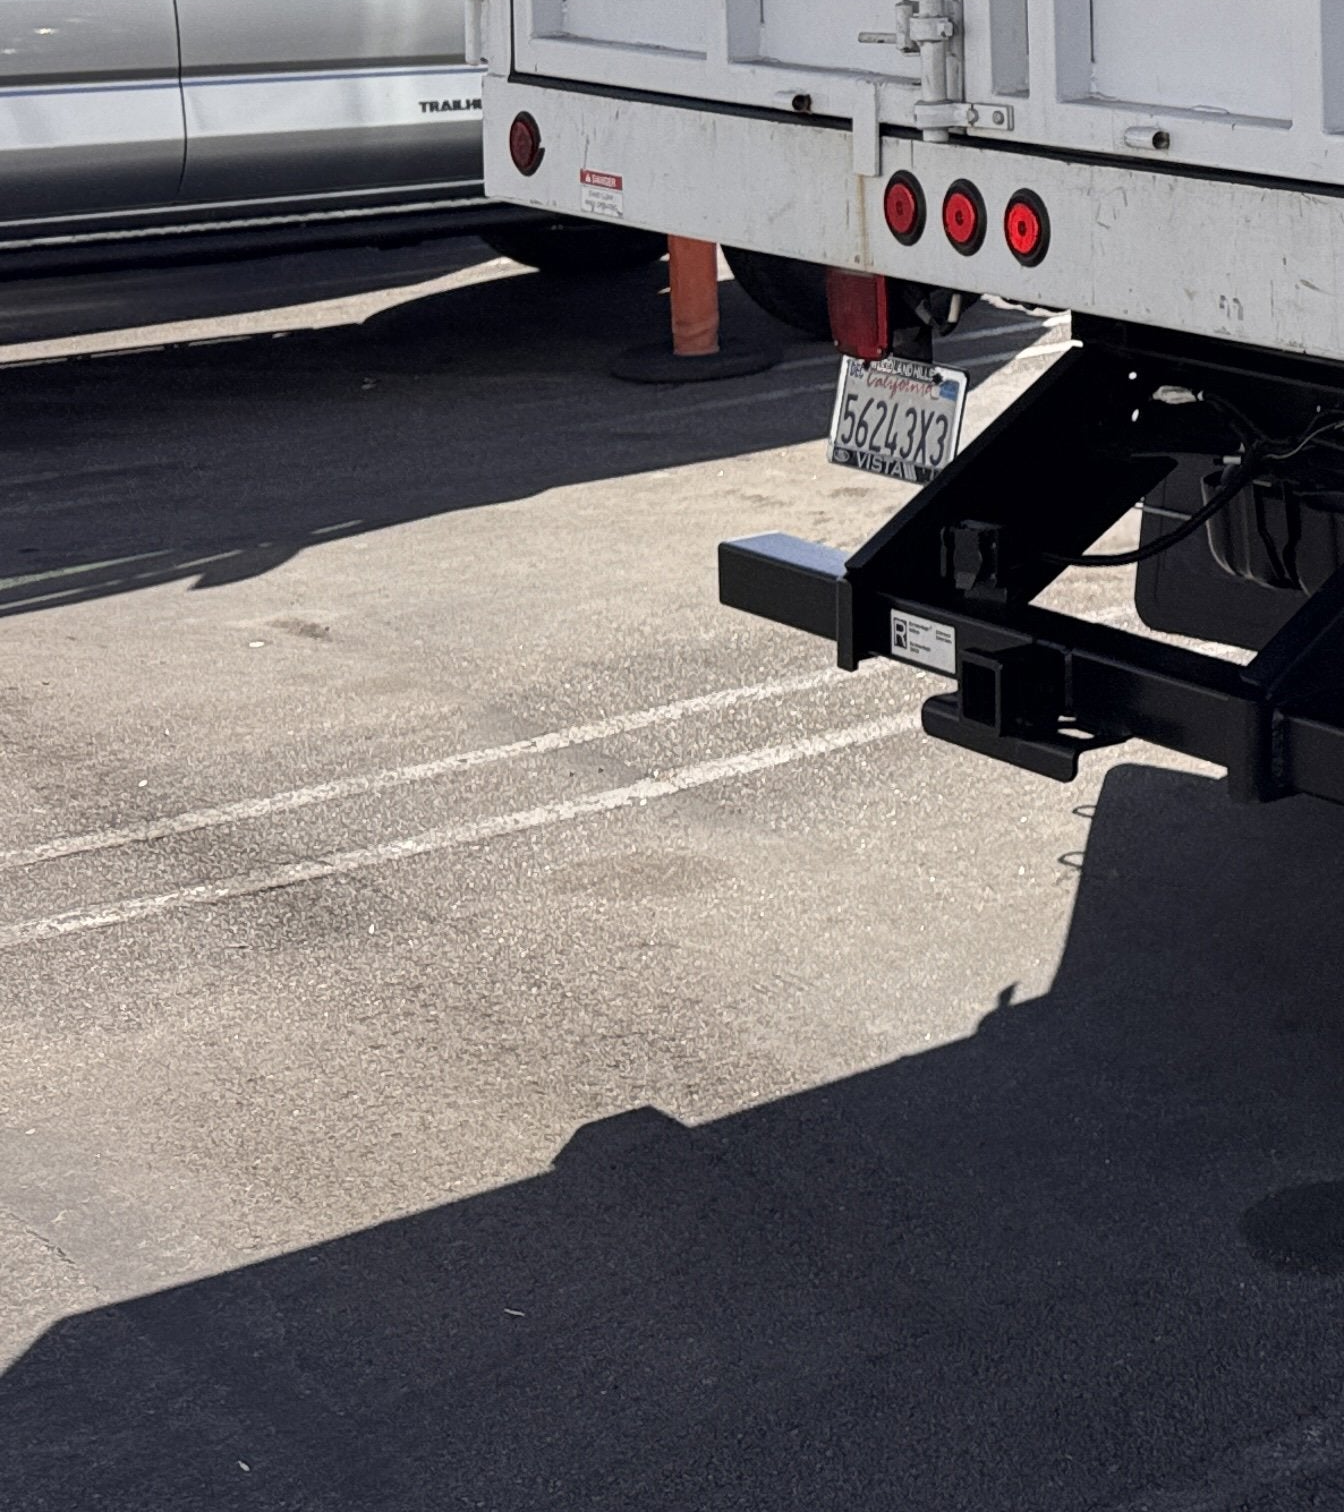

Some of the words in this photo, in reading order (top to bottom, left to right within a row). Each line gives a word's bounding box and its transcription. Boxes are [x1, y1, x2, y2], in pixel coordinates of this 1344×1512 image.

[866, 369, 939, 400] California
[841, 393, 949, 467] 56243X3
[856, 450, 903, 479] VISTA
